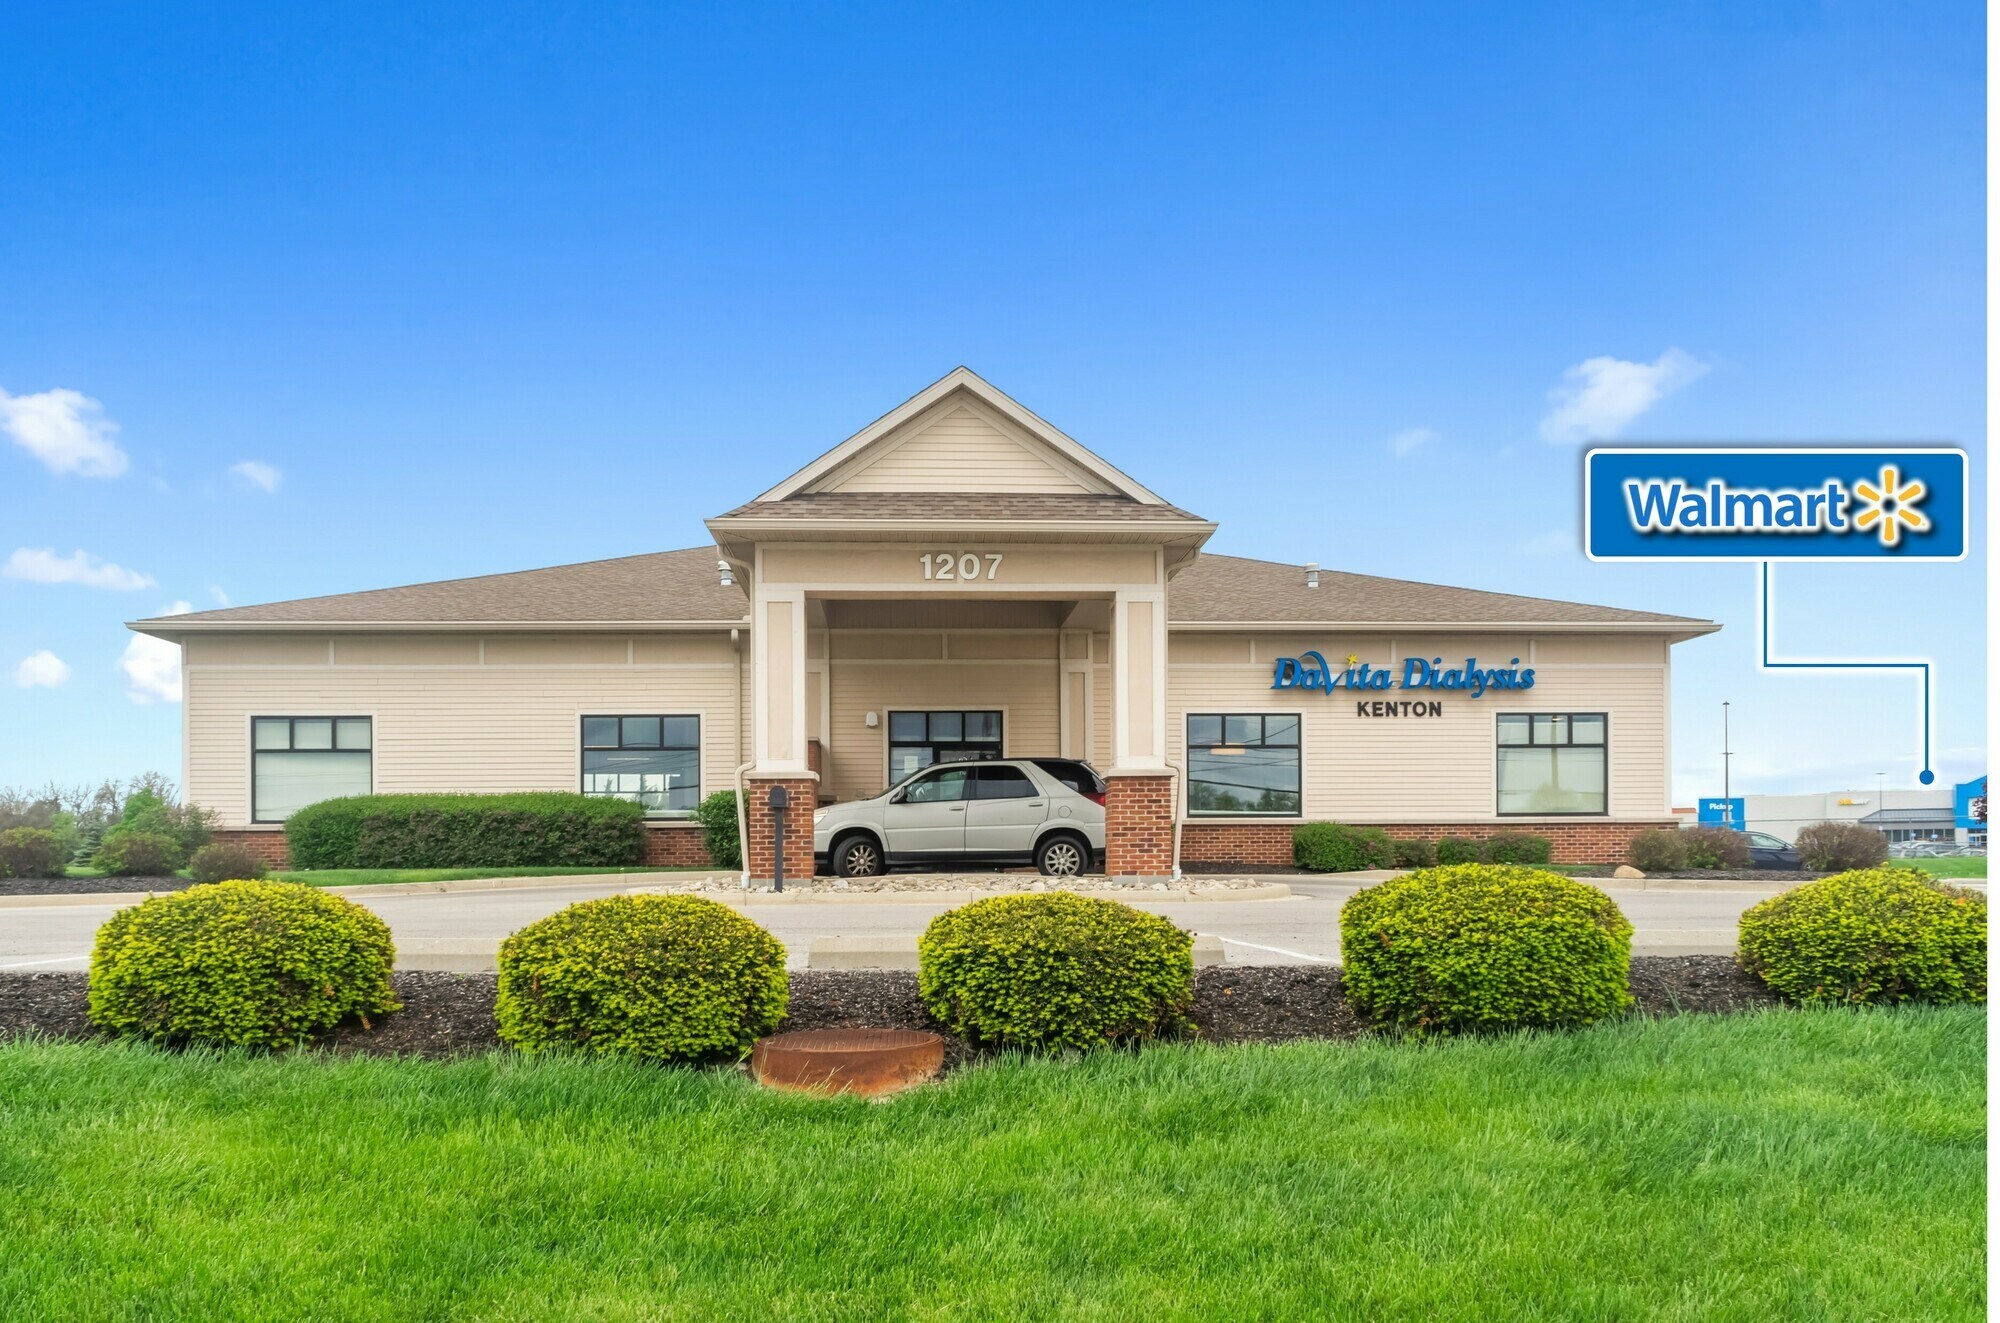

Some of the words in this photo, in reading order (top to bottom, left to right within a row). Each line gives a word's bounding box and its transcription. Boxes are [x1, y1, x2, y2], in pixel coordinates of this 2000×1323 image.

[919, 553, 1003, 580] 1207
[1271, 650, 1394, 696] DaVita
[1398, 657, 1535, 698] Dialysis
[1357, 701, 1442, 717] KENTON
